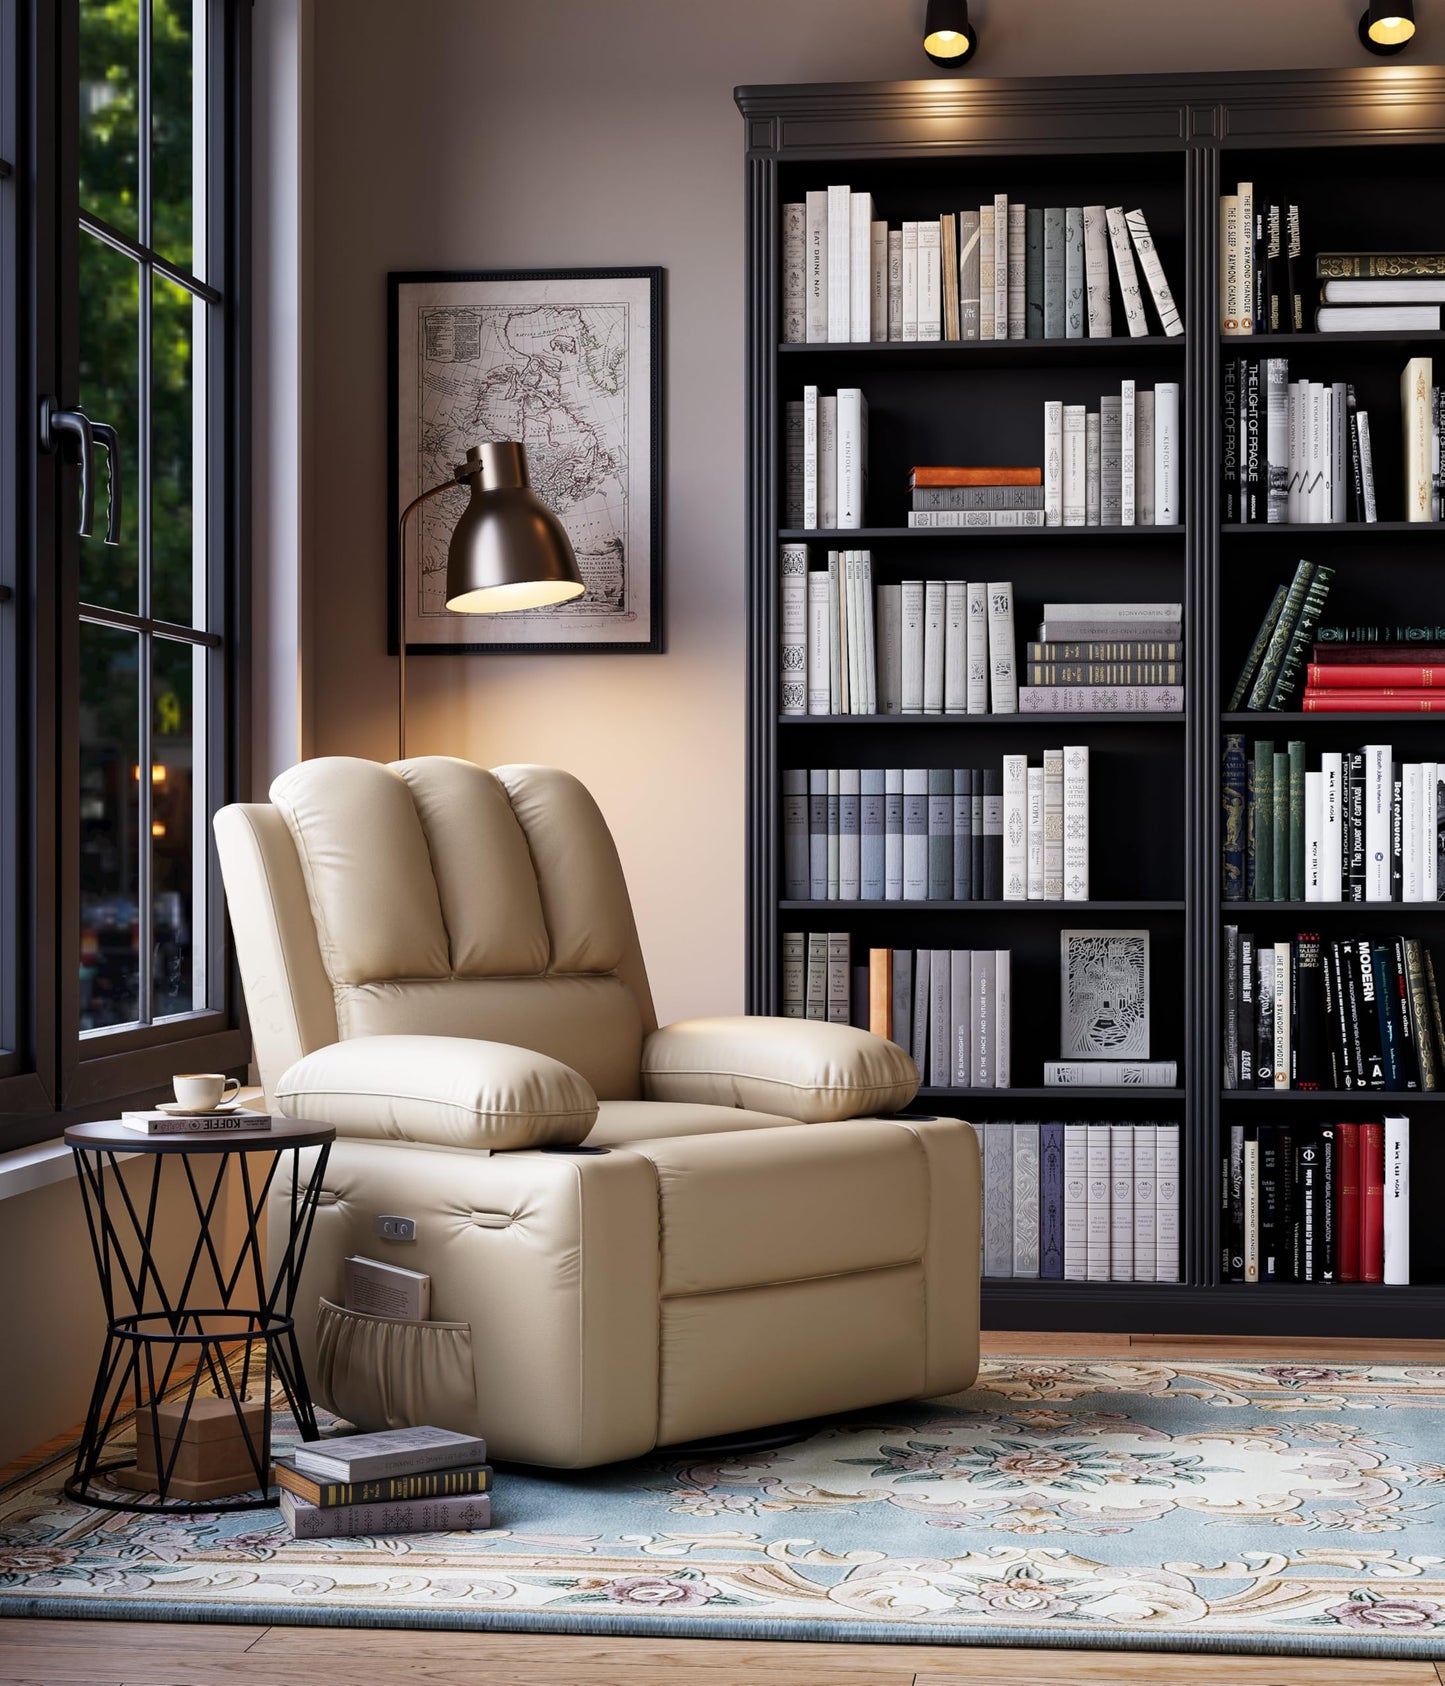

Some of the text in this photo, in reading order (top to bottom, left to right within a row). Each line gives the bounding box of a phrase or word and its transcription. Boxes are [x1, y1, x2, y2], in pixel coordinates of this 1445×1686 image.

[1268, 205, 1280, 258] Weltarchitektur
[1287, 205, 1301, 258] Weltarchitektur
[1228, 208, 1236, 315] THE BIG SLEEP RAYMOND CHANDLER
[1225, 362, 1235, 480] THE LIGHT OF PRAGUE
[1249, 364, 1258, 481] THE LIGHT OF PRAGUE
[1350, 415, 1361, 494] Kindergarten
[1352, 755, 1362, 769] The
[1342, 806, 1348, 818] of
[1352, 787, 1364, 867] The power of carnival
[1394, 782, 1402, 856] Best restaurants
[1324, 957, 1332, 1013] Weltarchitektur
[1358, 942, 1374, 1002] MODERN
[1372, 1065, 1382, 1077] A
[203, 1119, 240, 1129] KOFFIE
[1231, 1142, 1242, 1199] Perfect Story
